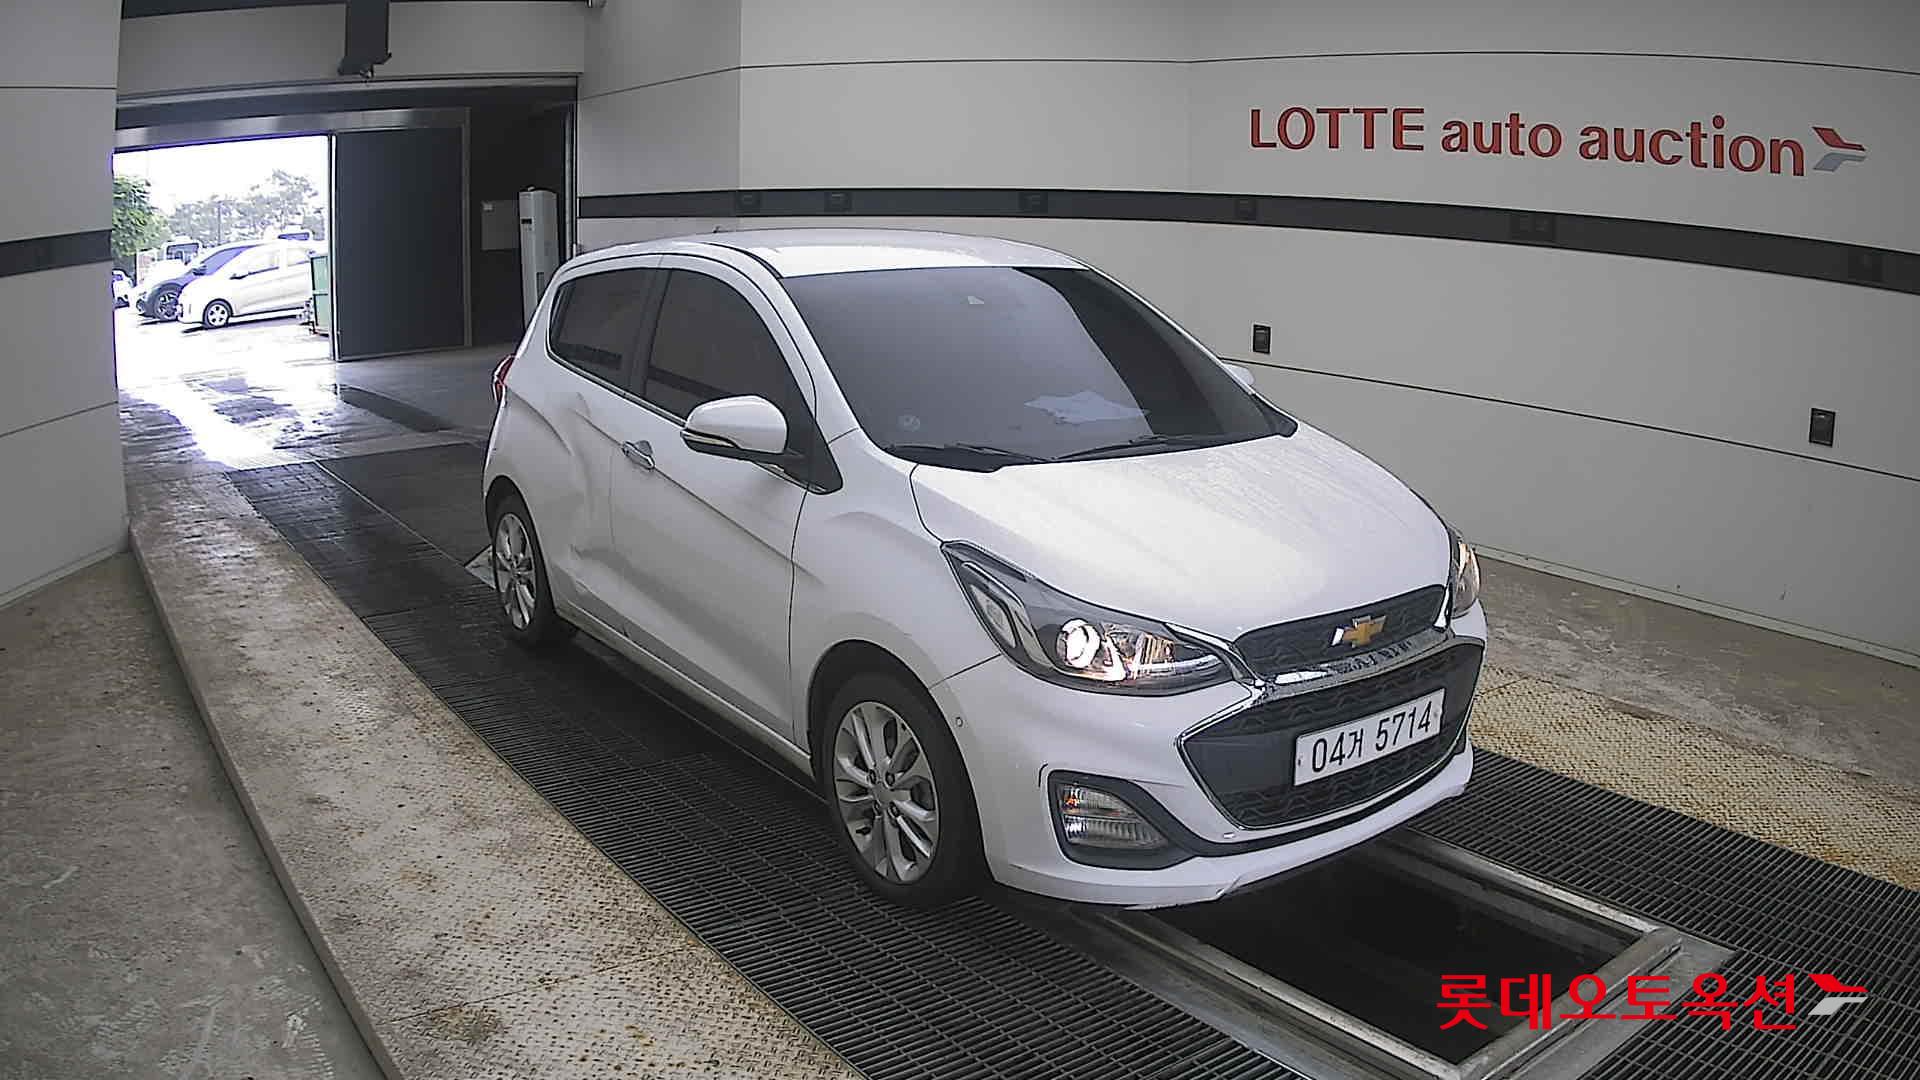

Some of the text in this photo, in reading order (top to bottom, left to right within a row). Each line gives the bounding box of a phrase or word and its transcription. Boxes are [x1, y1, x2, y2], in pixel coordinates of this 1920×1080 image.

[1250, 107, 1805, 176] LOTTE auto auction
[1312, 700, 1432, 772] 04거 5714
